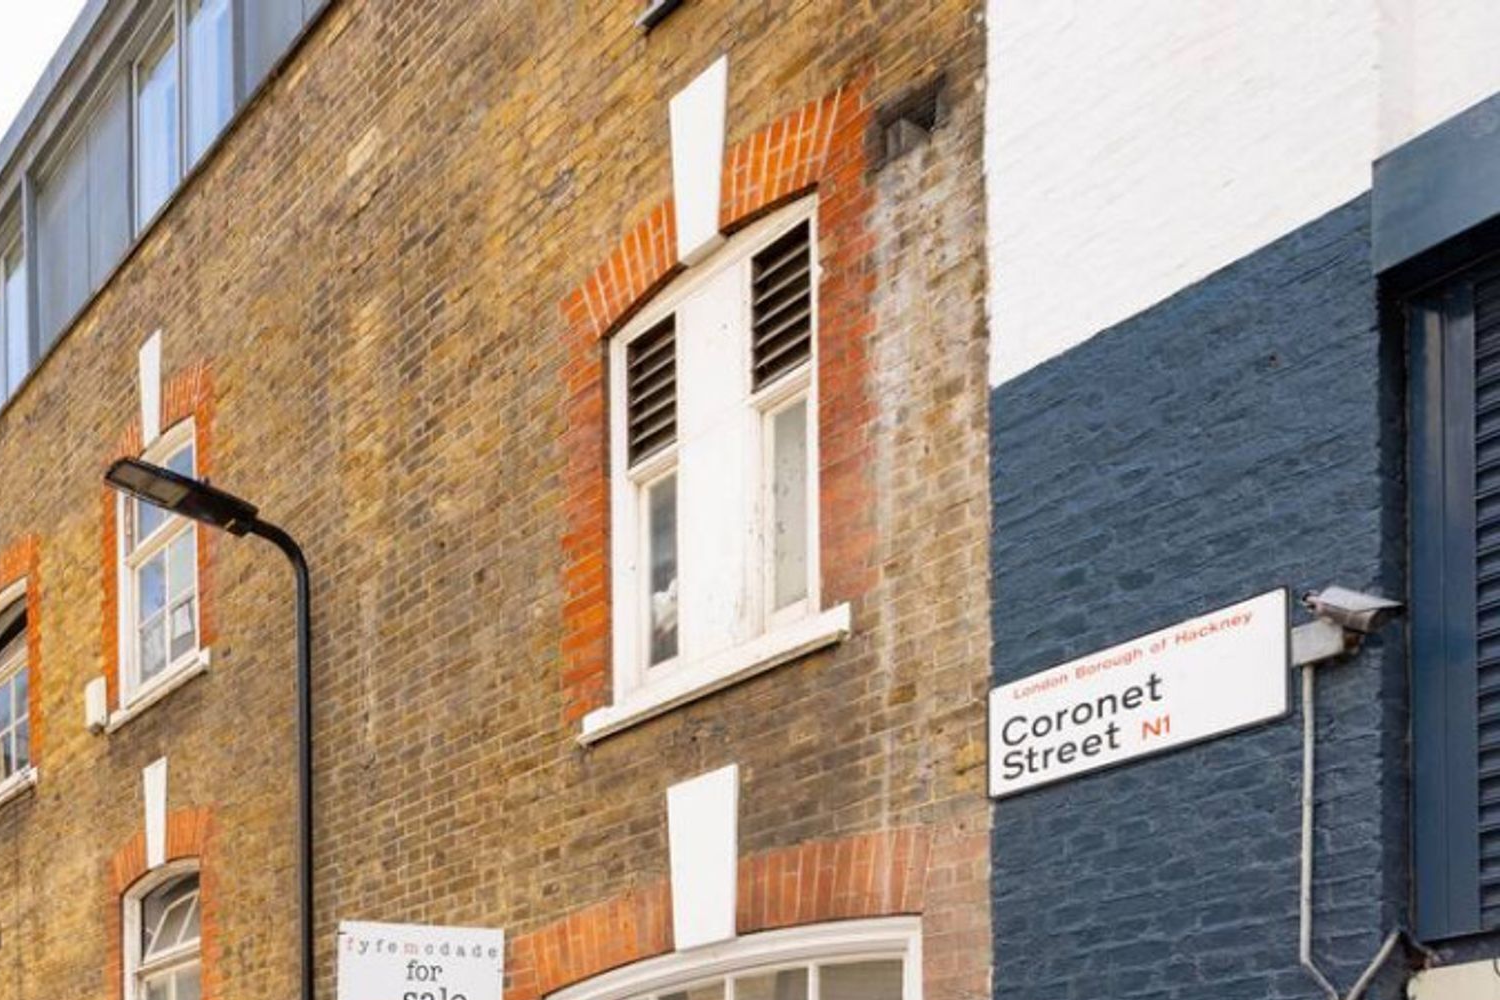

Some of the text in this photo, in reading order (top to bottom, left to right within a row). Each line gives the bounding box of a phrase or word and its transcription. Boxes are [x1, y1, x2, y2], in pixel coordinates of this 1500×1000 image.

[1012, 611, 1253, 699] London Borough of Hackney
[1002, 672, 1163, 747] Coronet
[1002, 714, 1172, 781] Street N1
[406, 959, 443, 982] for
